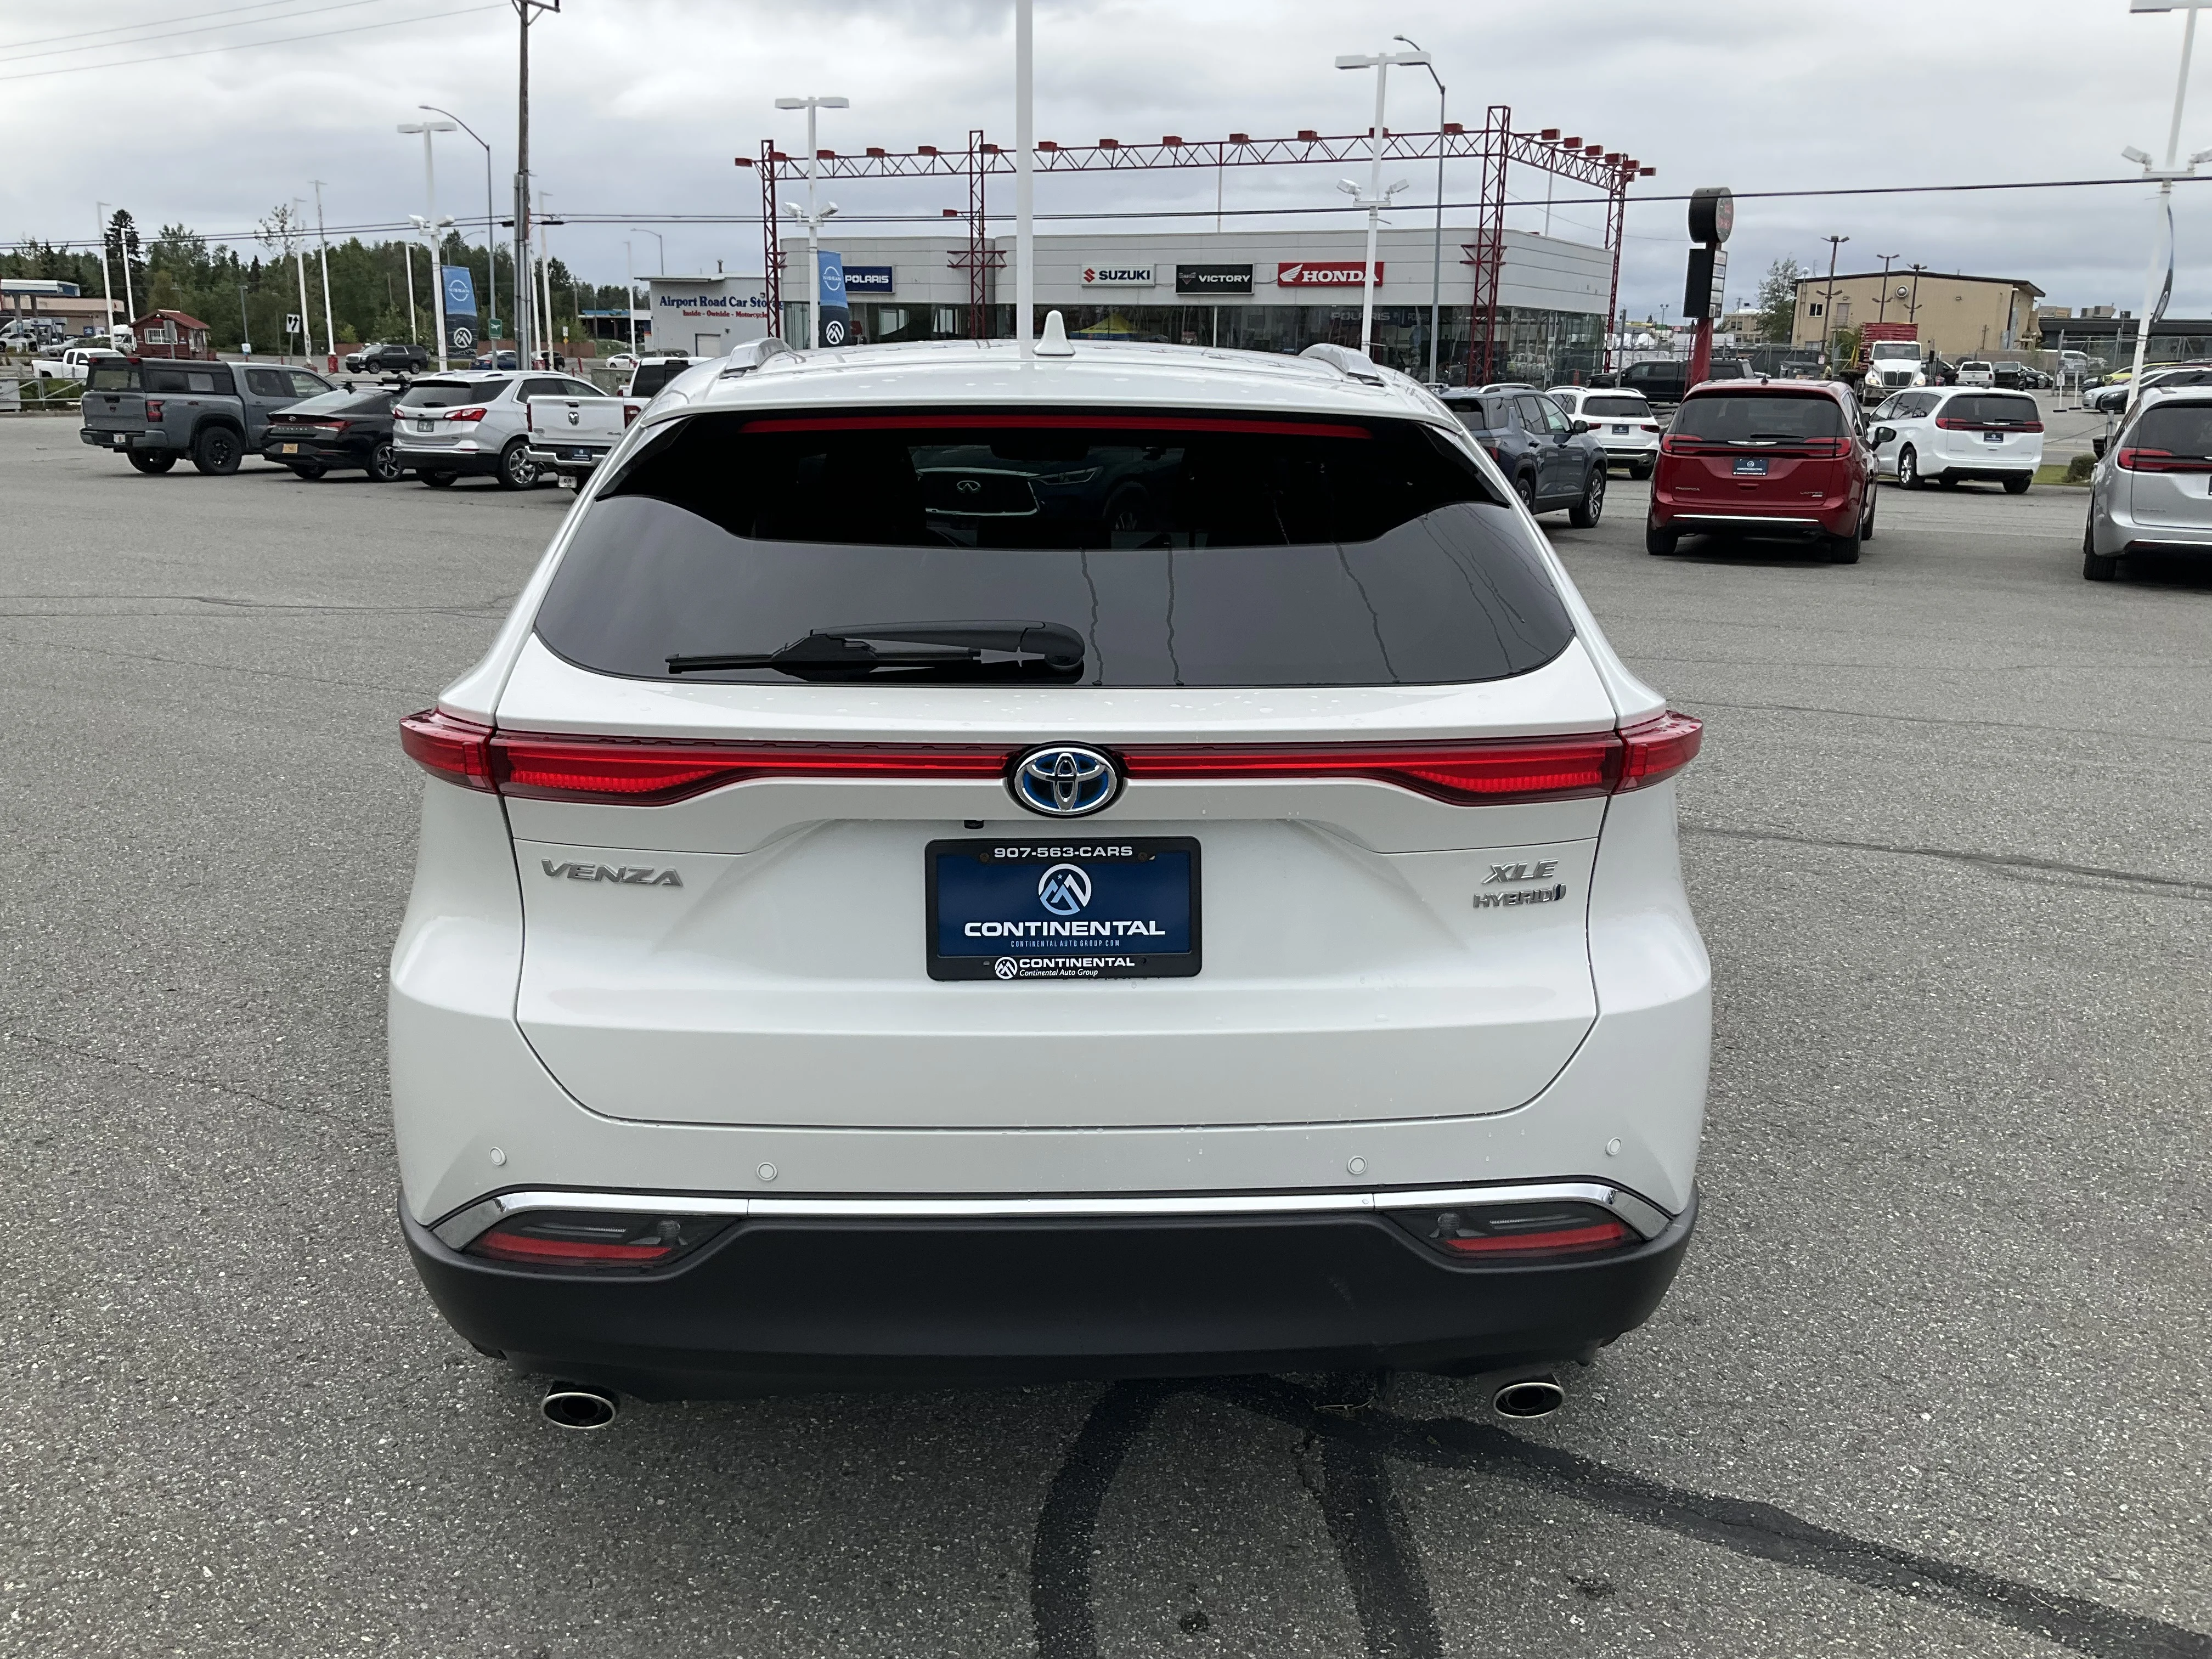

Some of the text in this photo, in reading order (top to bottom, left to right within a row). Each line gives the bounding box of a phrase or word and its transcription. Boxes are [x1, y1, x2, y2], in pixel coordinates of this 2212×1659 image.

[845, 275, 889, 284] POLARIS
[1099, 270, 1150, 280] SUZUKI
[1198, 274, 1250, 283] VICTORY
[659, 296, 697, 308] Airport
[699, 296, 726, 307] Road
[729, 296, 748, 307] Car
[994, 847, 1133, 857] 907-563-CARS
[541, 858, 684, 887] VENZA
[1481, 859, 1559, 884] XLE
[1473, 887, 1554, 909] HYBRID
[964, 921, 1166, 936] CONTINENTAL
[1019, 957, 1135, 968] CONTINENTAL
[1077, 969, 1098, 977] Group
